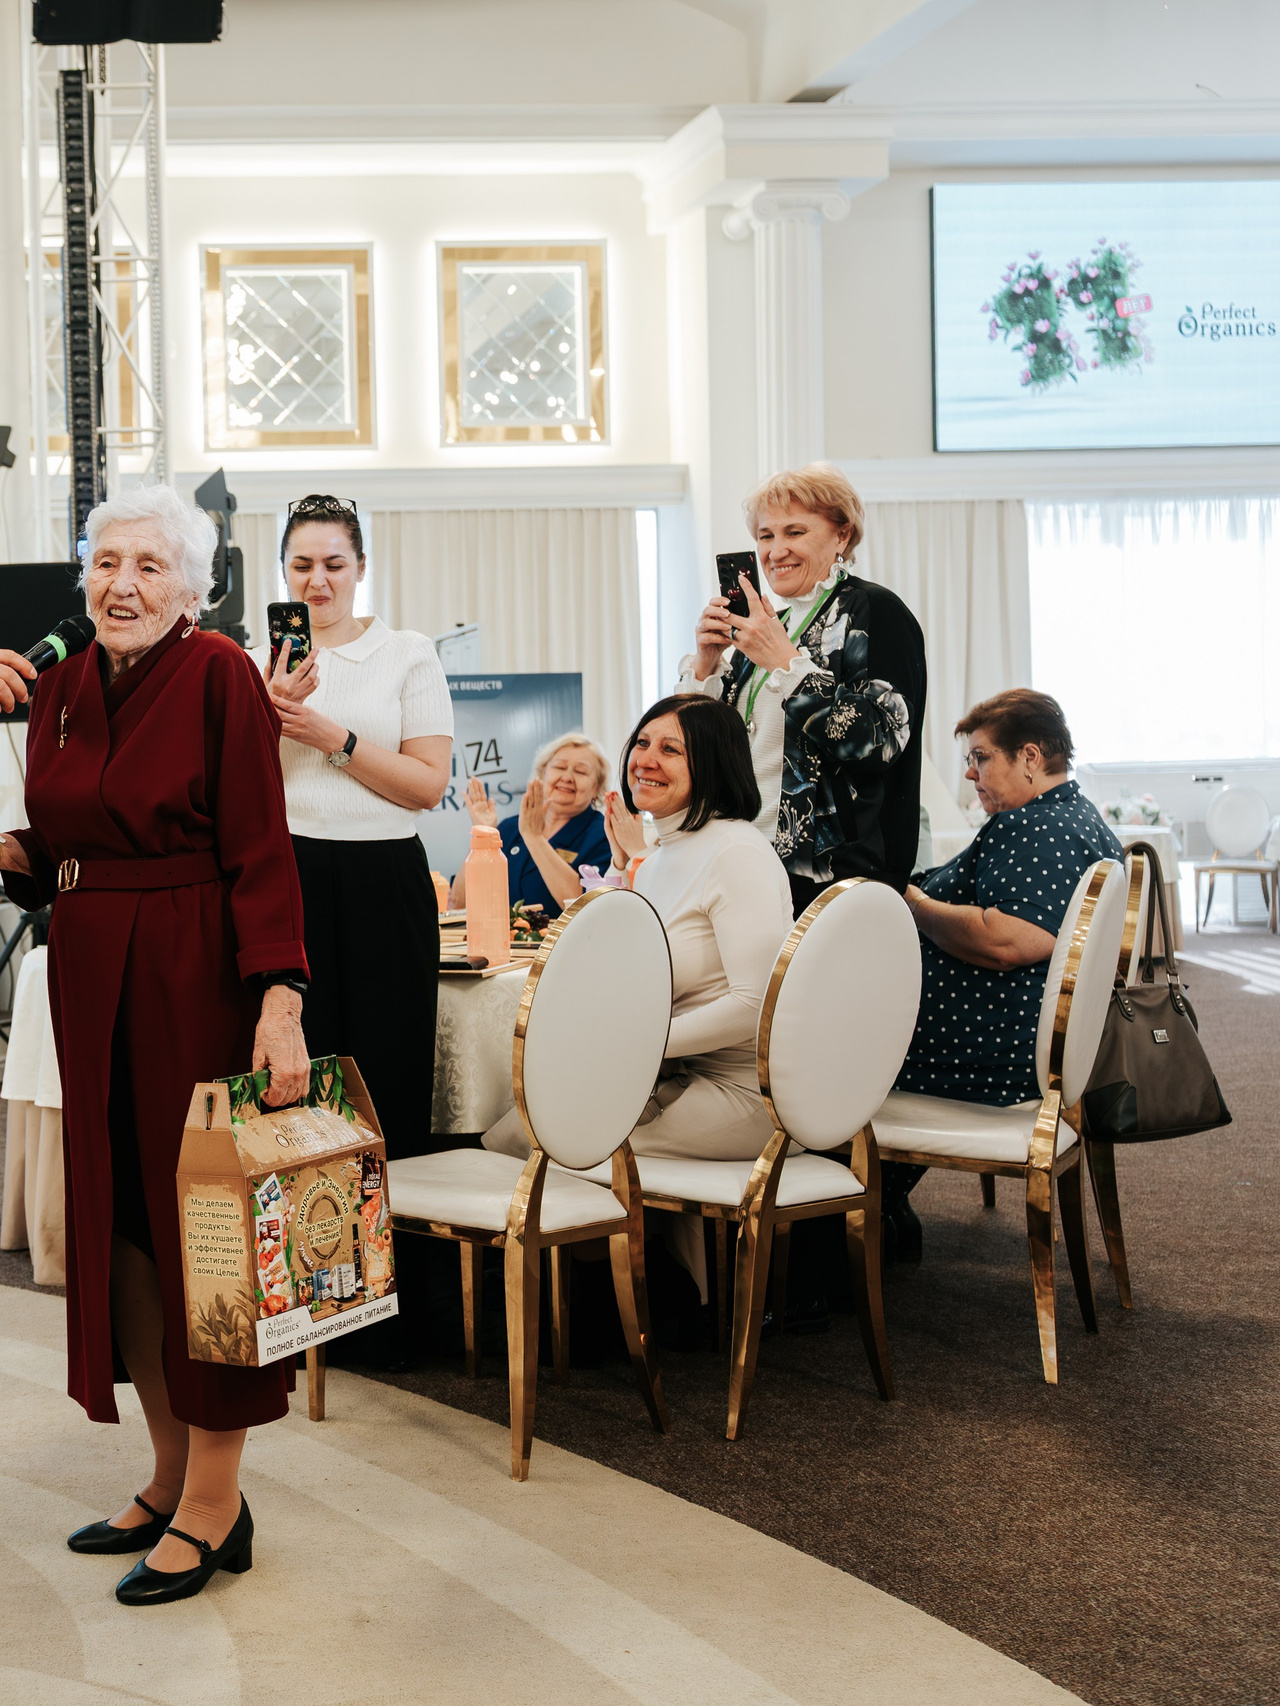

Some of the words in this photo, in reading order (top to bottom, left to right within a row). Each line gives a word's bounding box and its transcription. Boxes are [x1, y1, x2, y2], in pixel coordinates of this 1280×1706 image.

[1201, 302, 1257, 319] Perfect
[1178, 316, 1277, 341] Organics
[460, 680, 502, 692] ВЕЩЕСТВ
[191, 1198, 204, 1206] Мы
[206, 1200, 234, 1208] делаем
[297, 1181, 320, 1228] Здоровье
[327, 1178, 349, 1214] Энергия
[187, 1211, 240, 1220] качественные
[195, 1222, 233, 1232] продукты,
[305, 1224, 316, 1235] без
[317, 1216, 344, 1231] лекарств
[188, 1232, 199, 1240] Вы
[194, 1244, 244, 1255] эффективнее
[196, 1256, 237, 1266] достигаете
[193, 1267, 215, 1275] своих
[216, 1268, 242, 1278] Целей.
[273, 1315, 293, 1328] Perfect
[266, 1339, 294, 1357] ПОЛНОЕ
[296, 1315, 363, 1346] СБАЛАНСИРОВАННОЕ
[365, 1303, 392, 1320] ПИТАНИЕ
